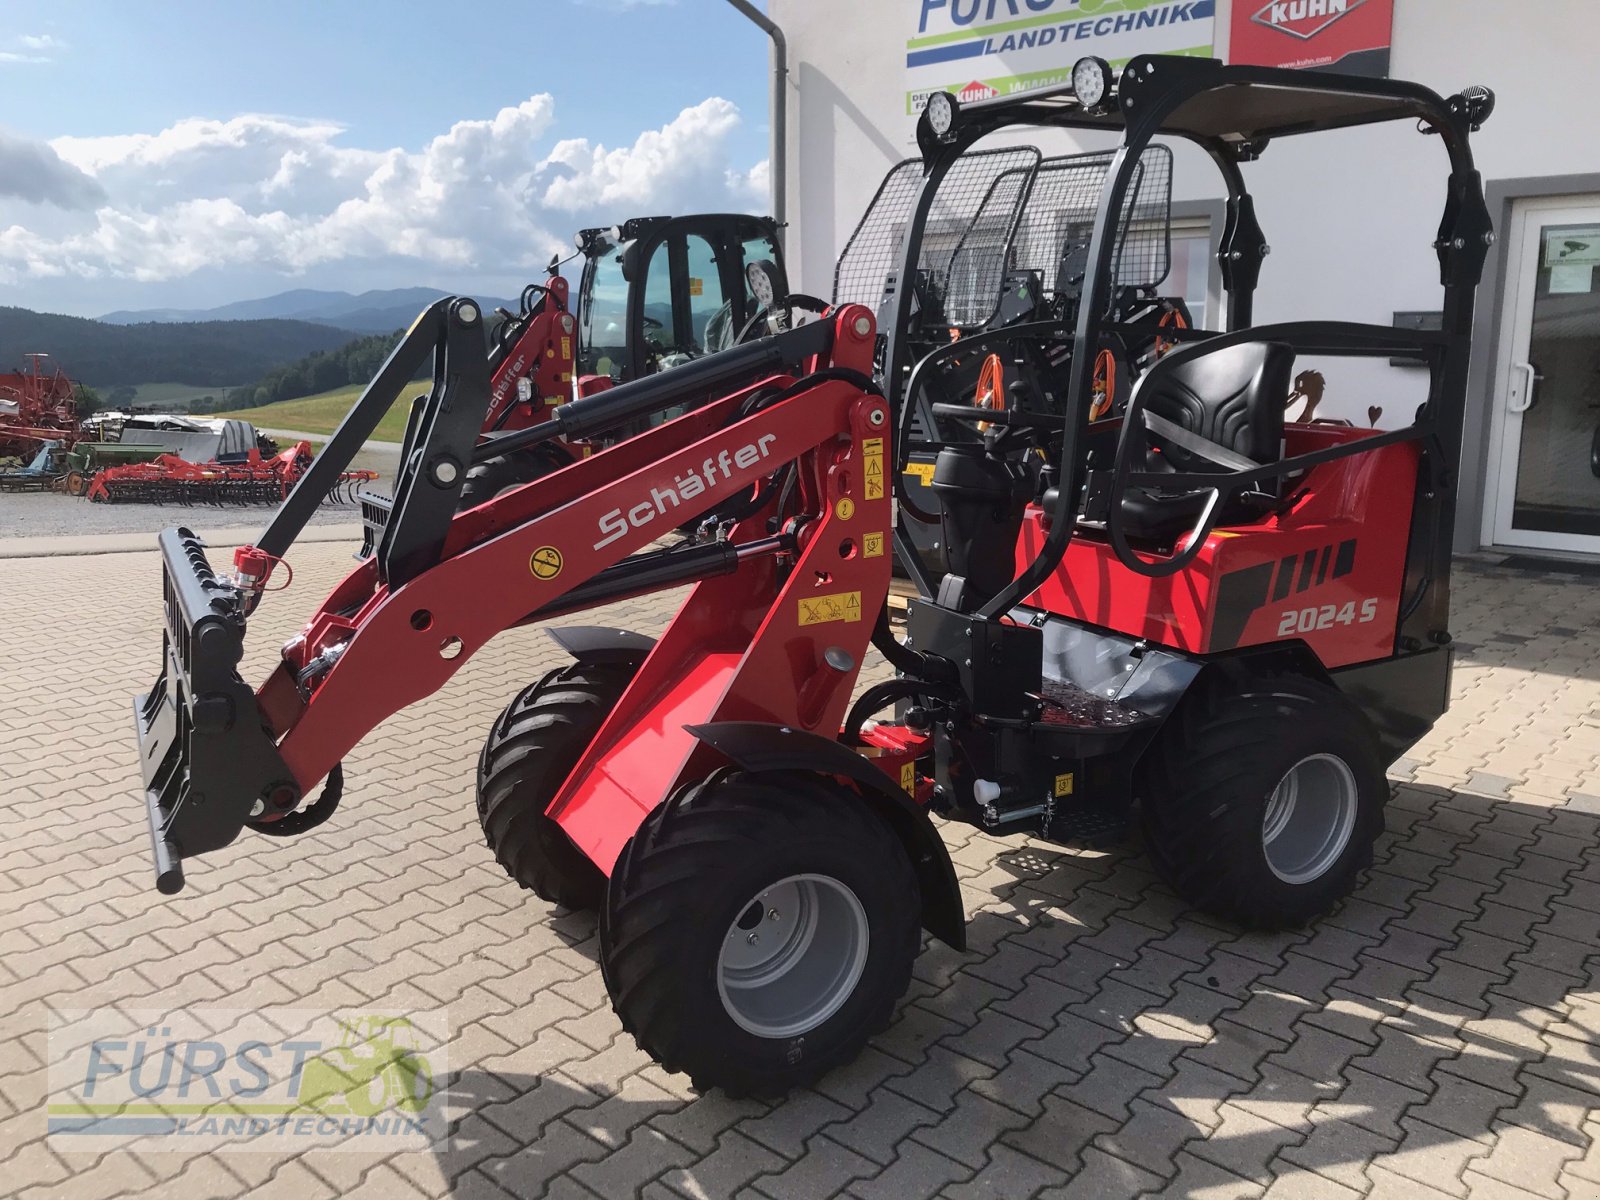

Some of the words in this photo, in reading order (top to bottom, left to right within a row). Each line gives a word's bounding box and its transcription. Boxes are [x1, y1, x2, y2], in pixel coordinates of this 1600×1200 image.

[1271, 0, 1347, 24] KUHN
[985, 2, 1193, 55] LANDTECHNIK
[1277, 56, 1332, 69] www.kuhn.com
[956, 87, 993, 103] KUHN
[593, 433, 776, 551] Schäffer
[1277, 601, 1356, 637] 2024
[1359, 597, 1378, 623] S
